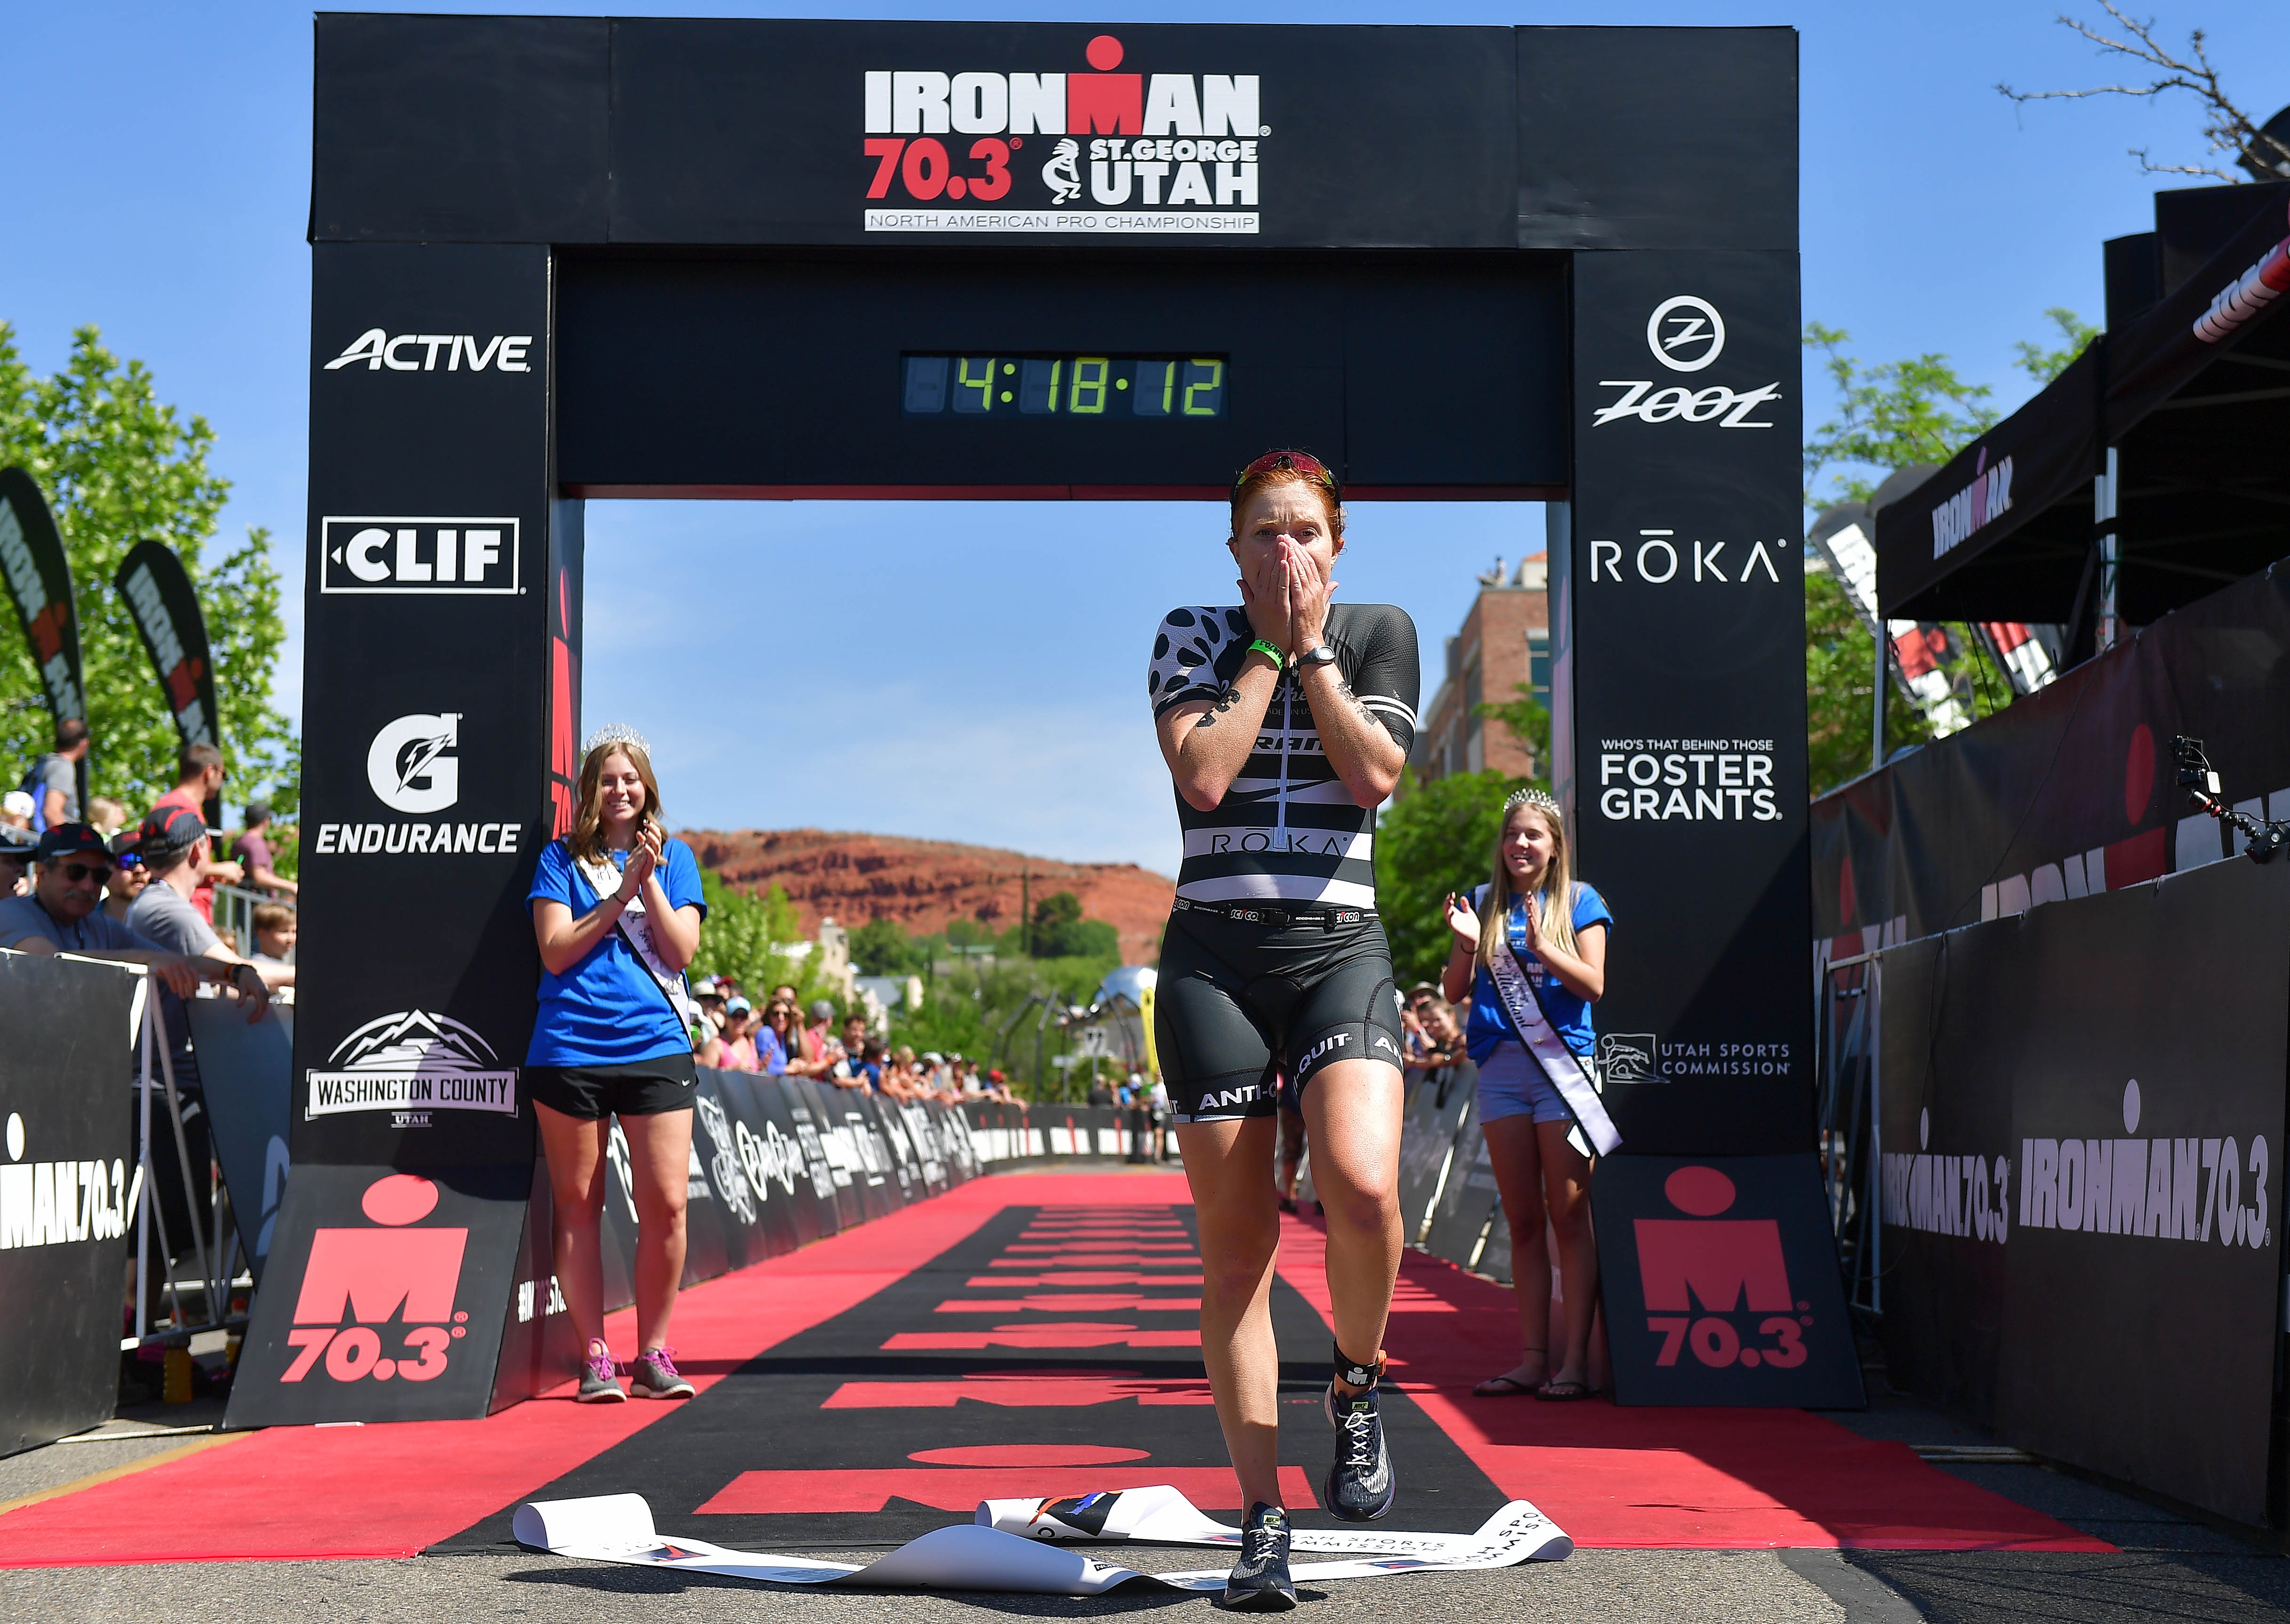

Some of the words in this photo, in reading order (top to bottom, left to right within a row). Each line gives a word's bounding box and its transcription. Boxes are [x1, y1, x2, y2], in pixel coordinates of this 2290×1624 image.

[864, 71, 1260, 136] IRONMAN
[864, 137, 1012, 201] 70.3
[1090, 161, 1259, 206] UTAH
[869, 215, 939, 228] NORTH
[946, 216, 1049, 228] AMERICAN
[1056, 216, 1097, 228] PRO
[1104, 216, 1255, 229] CHAMPIONSHIP
[323, 328, 532, 372] ACTIVE
[1932, 453, 2013, 560] IRONMAN
[346, 528, 501, 582] CLIF
[1253, 736, 1324, 750] RAM
[1601, 739, 1644, 751] WHO'S
[1647, 739, 1679, 751] THAT
[1682, 739, 1729, 751] BEHIND
[1732, 739, 1774, 751] THOSE
[1601, 754, 1774, 786] FOSTER
[315, 823, 522, 854] ENDURANCE
[1661, 1043, 1711, 1057] UTAH
[1720, 1043, 1789, 1057] SPORTS
[1662, 1061, 1788, 1075] COMMISSION
[318, 1078, 432, 1105] WASHINGTON
[440, 1078, 508, 1104] COUNTY
[395, 1115, 429, 1124] UTAH
[280, 1326, 450, 1382] 70.3
[1647, 1316, 1808, 1368] 70.3
[1349, 1537, 1446, 1548] SPORTS
